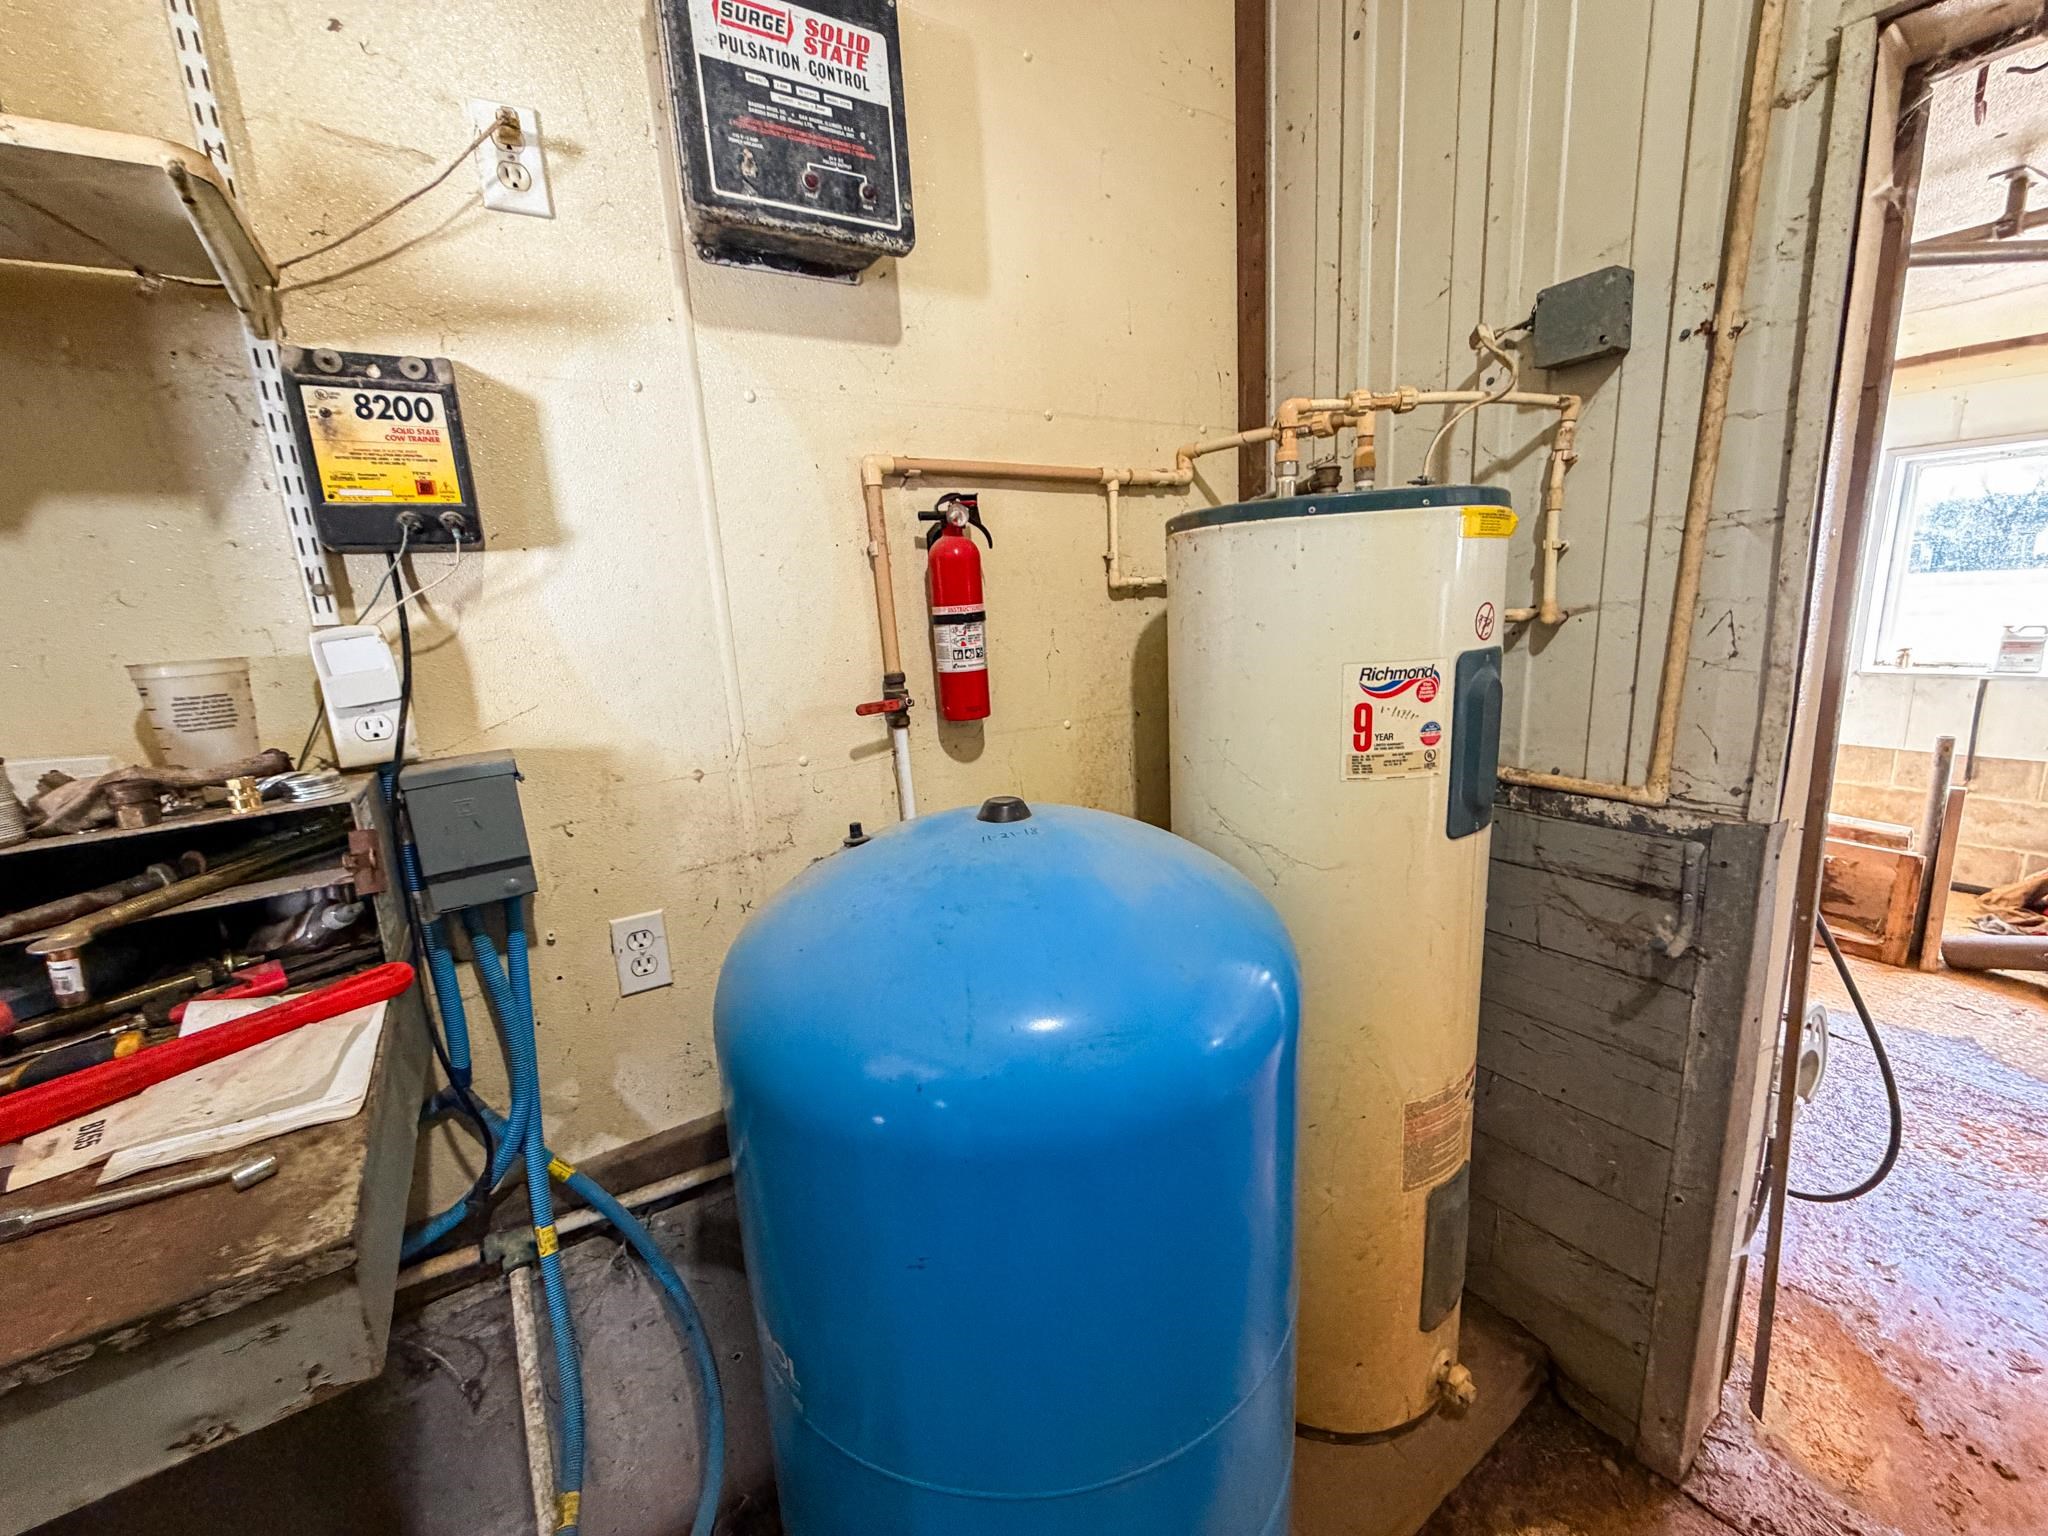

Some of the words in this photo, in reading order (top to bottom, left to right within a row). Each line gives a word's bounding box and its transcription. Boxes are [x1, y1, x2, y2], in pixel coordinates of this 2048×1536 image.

[720, 1, 786, 35] SURGE
[805, 18, 870, 54] SOLID
[718, 32, 801, 71] PULSATION
[808, 60, 870, 92] CONTROL
[803, 37, 869, 72] STATE
[353, 393, 434, 423] 8200
[384, 434, 406, 442] COW
[407, 435, 441, 443] TRAINER
[391, 427, 415, 435] SOLID
[416, 428, 440, 436] STATE
[1360, 664, 1435, 681] Richmond
[1353, 702, 1373, 752] 9
[1374, 732, 1394, 741] YEAR
